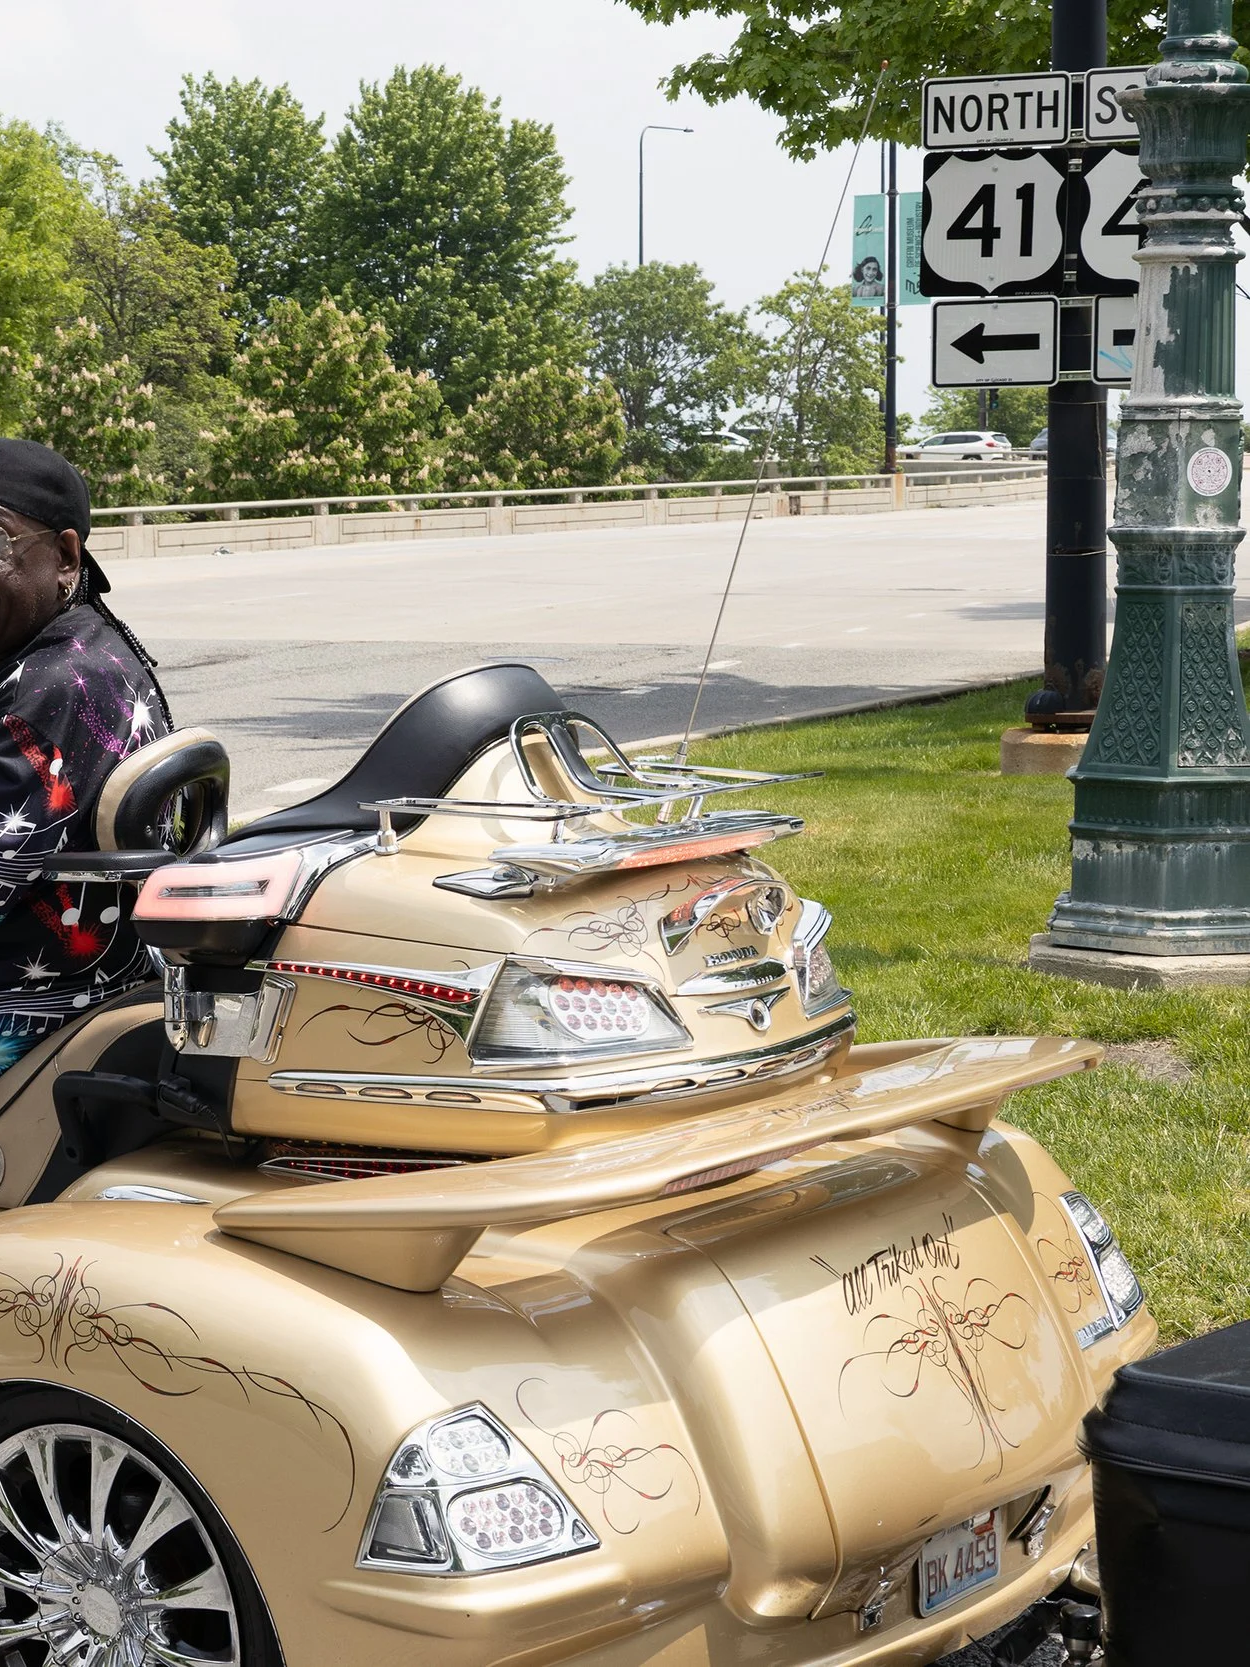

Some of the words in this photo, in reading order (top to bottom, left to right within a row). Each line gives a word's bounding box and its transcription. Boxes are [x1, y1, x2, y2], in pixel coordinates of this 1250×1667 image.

[933, 89, 1059, 134] NORTH
[906, 217, 915, 244] MUSEUM
[946, 182, 1035, 258] 41
[906, 246, 915, 268] GRIFFIN
[702, 945, 759, 968] HONDA
[866, 1236, 924, 1295] Triked
[927, 1554, 948, 1597] BK
[953, 1531, 997, 1581] 4459
